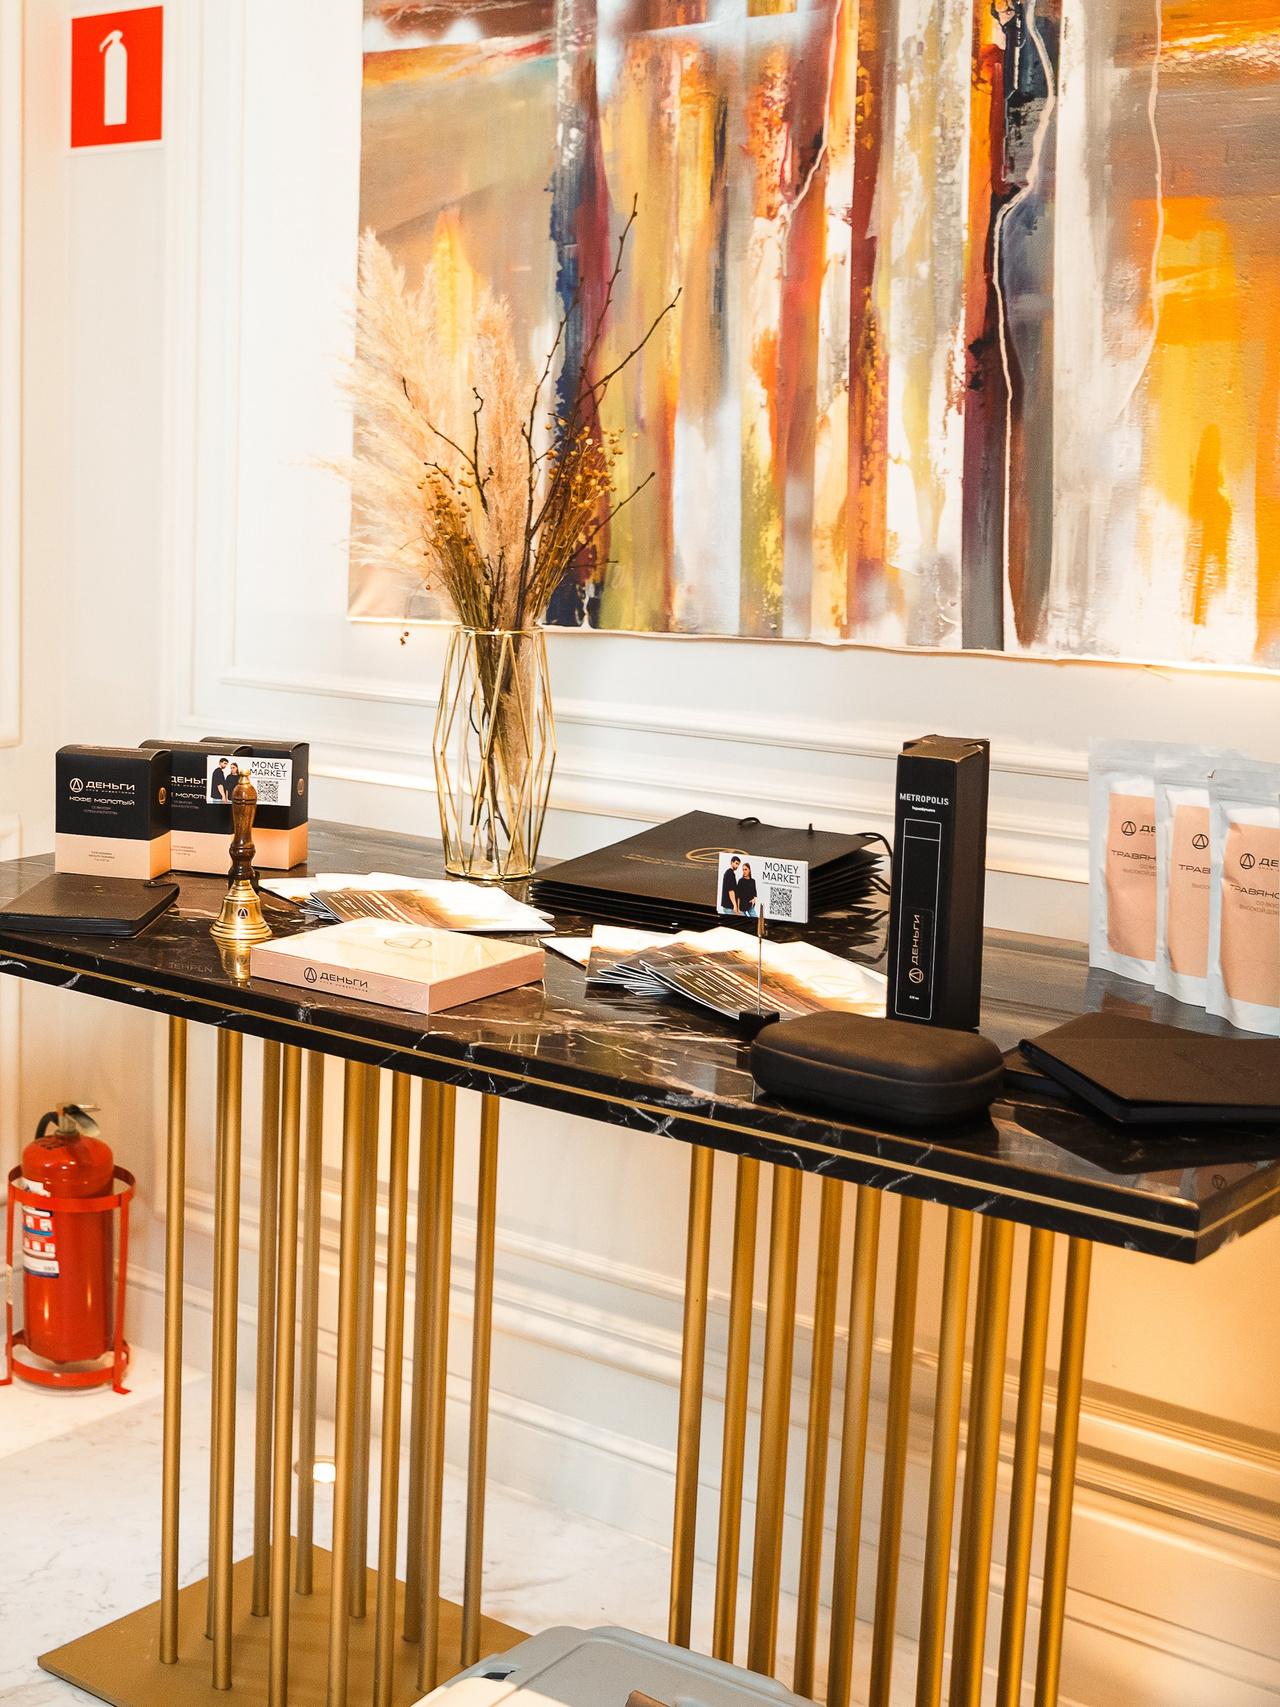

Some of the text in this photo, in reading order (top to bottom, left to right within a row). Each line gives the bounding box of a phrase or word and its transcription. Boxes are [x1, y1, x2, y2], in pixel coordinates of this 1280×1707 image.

[251, 761, 286, 770] MONEY
[250, 769, 287, 777] MARKET
[170, 775, 207, 784] ДЕНЬГ
[85, 781, 135, 791] ДЕНЬГИ
[175, 792, 207, 800] МОЛОТ
[899, 793, 949, 806] METROPOLIS
[94, 798, 135, 806] МОЛОТЫЙ
[1111, 849, 1157, 861] ТРАВЯН
[764, 862, 799, 874] MONEY
[1178, 864, 1211, 874] ТРАВ
[762, 871, 801, 884] MARKET
[1230, 884, 1280, 900] ТРАВЯНО
[911, 914, 920, 966] ДЕНЬГИ
[320, 972, 368, 988] ДЕНЬГИ
